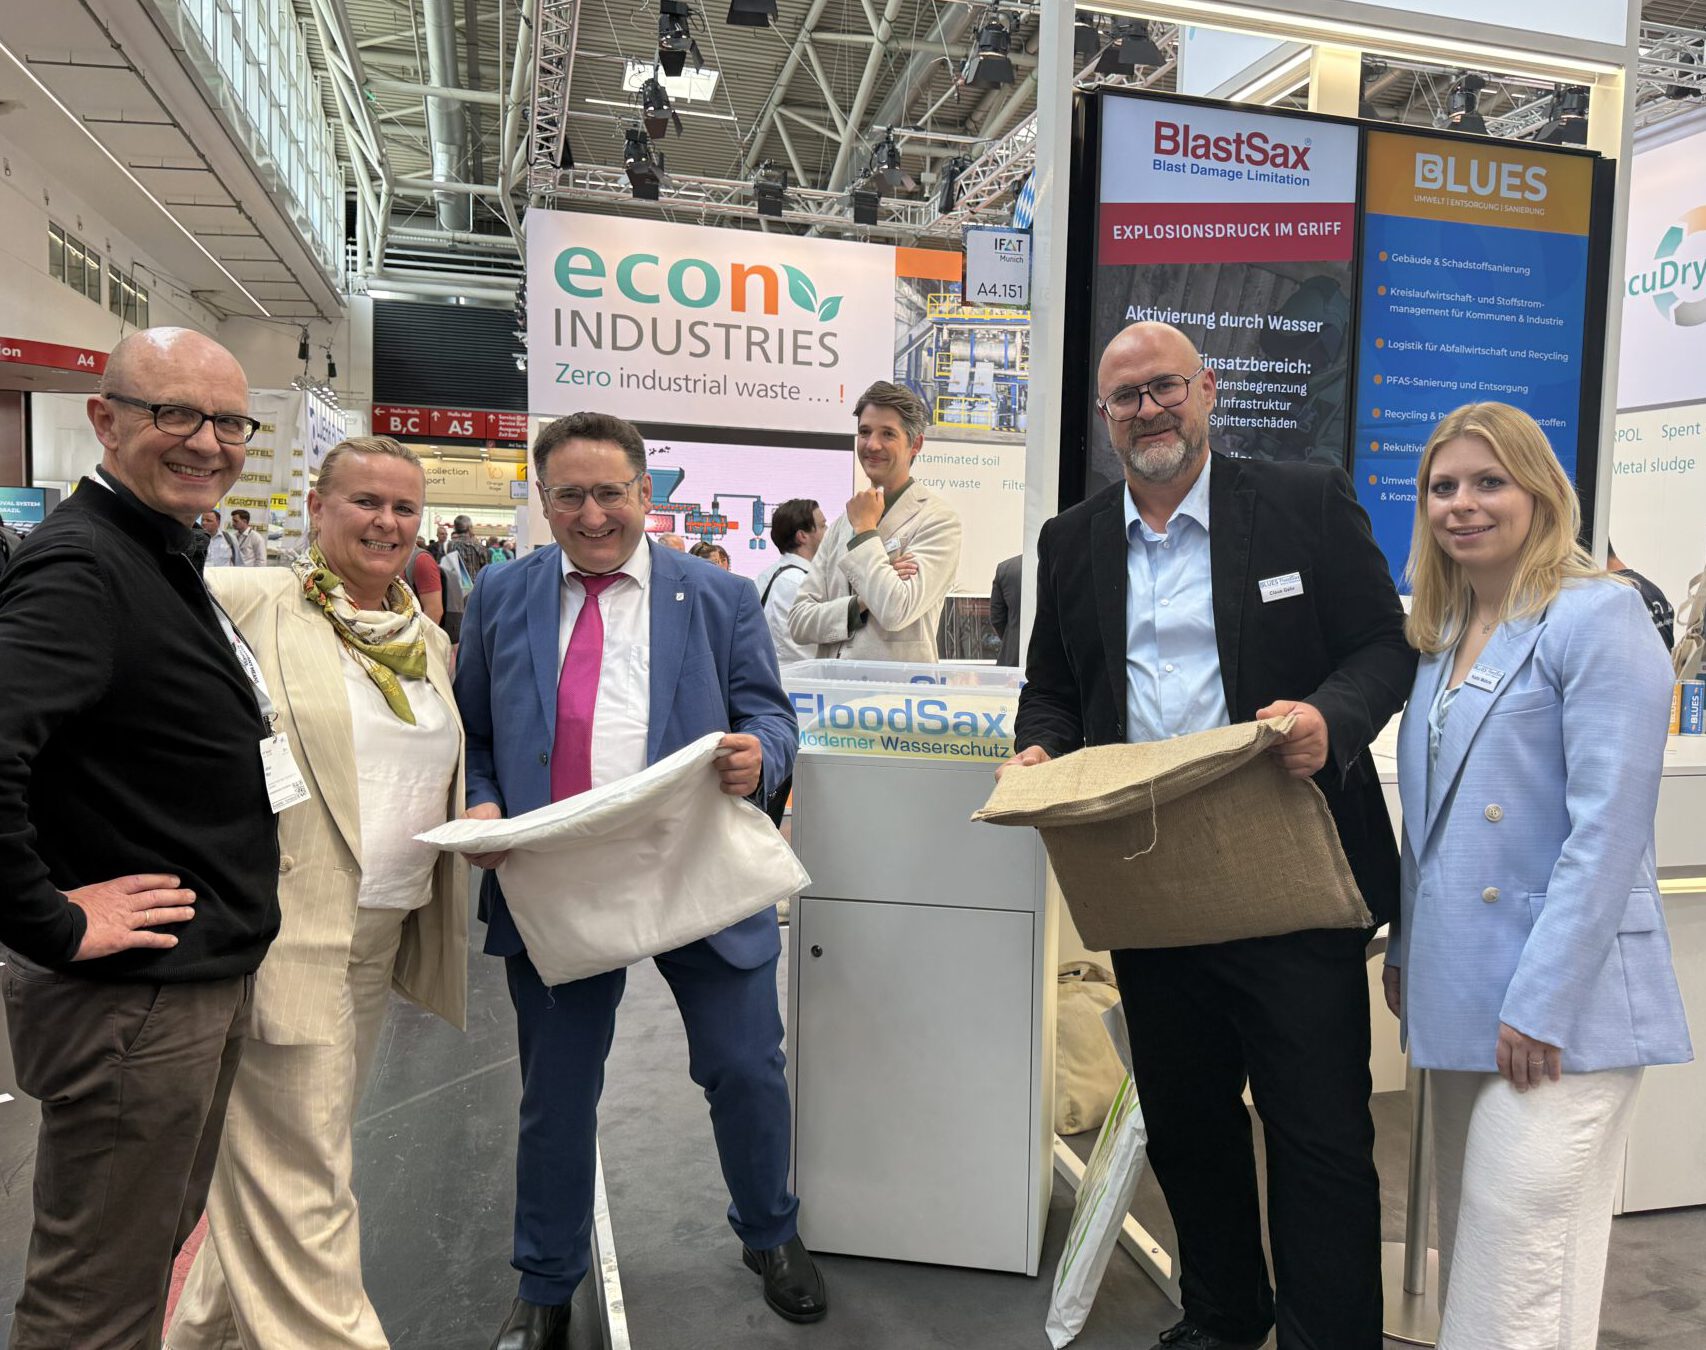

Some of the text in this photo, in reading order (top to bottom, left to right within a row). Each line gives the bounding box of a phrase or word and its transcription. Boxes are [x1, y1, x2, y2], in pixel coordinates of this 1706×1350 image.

[1153, 159, 1311, 187] Blast Damage Limitation
[1414, 152, 1548, 201] BLUES
[1413, 194, 1445, 205] UMWELT
[1450, 199, 1499, 211] ENTSORGUNG
[1504, 205, 1545, 216] SANIERUNG
[1113, 221, 1342, 240] EXPLOSIONSDRUCK IM GRIFF
[994, 237, 1024, 252] IFAT
[999, 254, 1024, 264] Munich
[1391, 253, 1531, 276] Gebäude & Schadstoffsanierung
[554, 246, 779, 316] econ
[977, 282, 1022, 299] A4.151
[1390, 287, 1545, 309] Kreislaufwirtschaft- und Stoffstrom-
[1125, 305, 1324, 333] Aktivierung durch Wasser
[1389, 304, 1564, 326] management für Kommunen & Industrie
[554, 308, 839, 368] INDUSTRIES
[77, 353, 95, 367] A4
[1388, 339, 1569, 363] Logistik für Abfallwirtschaft und Recycling
[555, 362, 611, 387] Zero
[620, 367, 727, 396] industrial
[735, 381, 801, 400] waste
[1216, 378, 1307, 396] densbegrenzung
[1386, 376, 1529, 394] PFAS-Sanierung und Entsorgung
[1220, 397, 1292, 411] Infrastruktur
[1209, 414, 1297, 430] Splitterschäden
[1385, 409, 1428, 421] Recycling
[1429, 412, 1436, 420] &
[389, 417, 420, 434] B,C
[448, 420, 473, 435] A5
[1661, 421, 1701, 439] Spent
[981, 455, 1000, 467] soil
[1650, 457, 1695, 474] sludge
[427, 467, 469, 476] collection
[949, 478, 981, 489] waste
[1380, 492, 1387, 501] &
[1690, 695, 1699, 724] BLUES
[880, 735, 1010, 758] Wasserschutz
